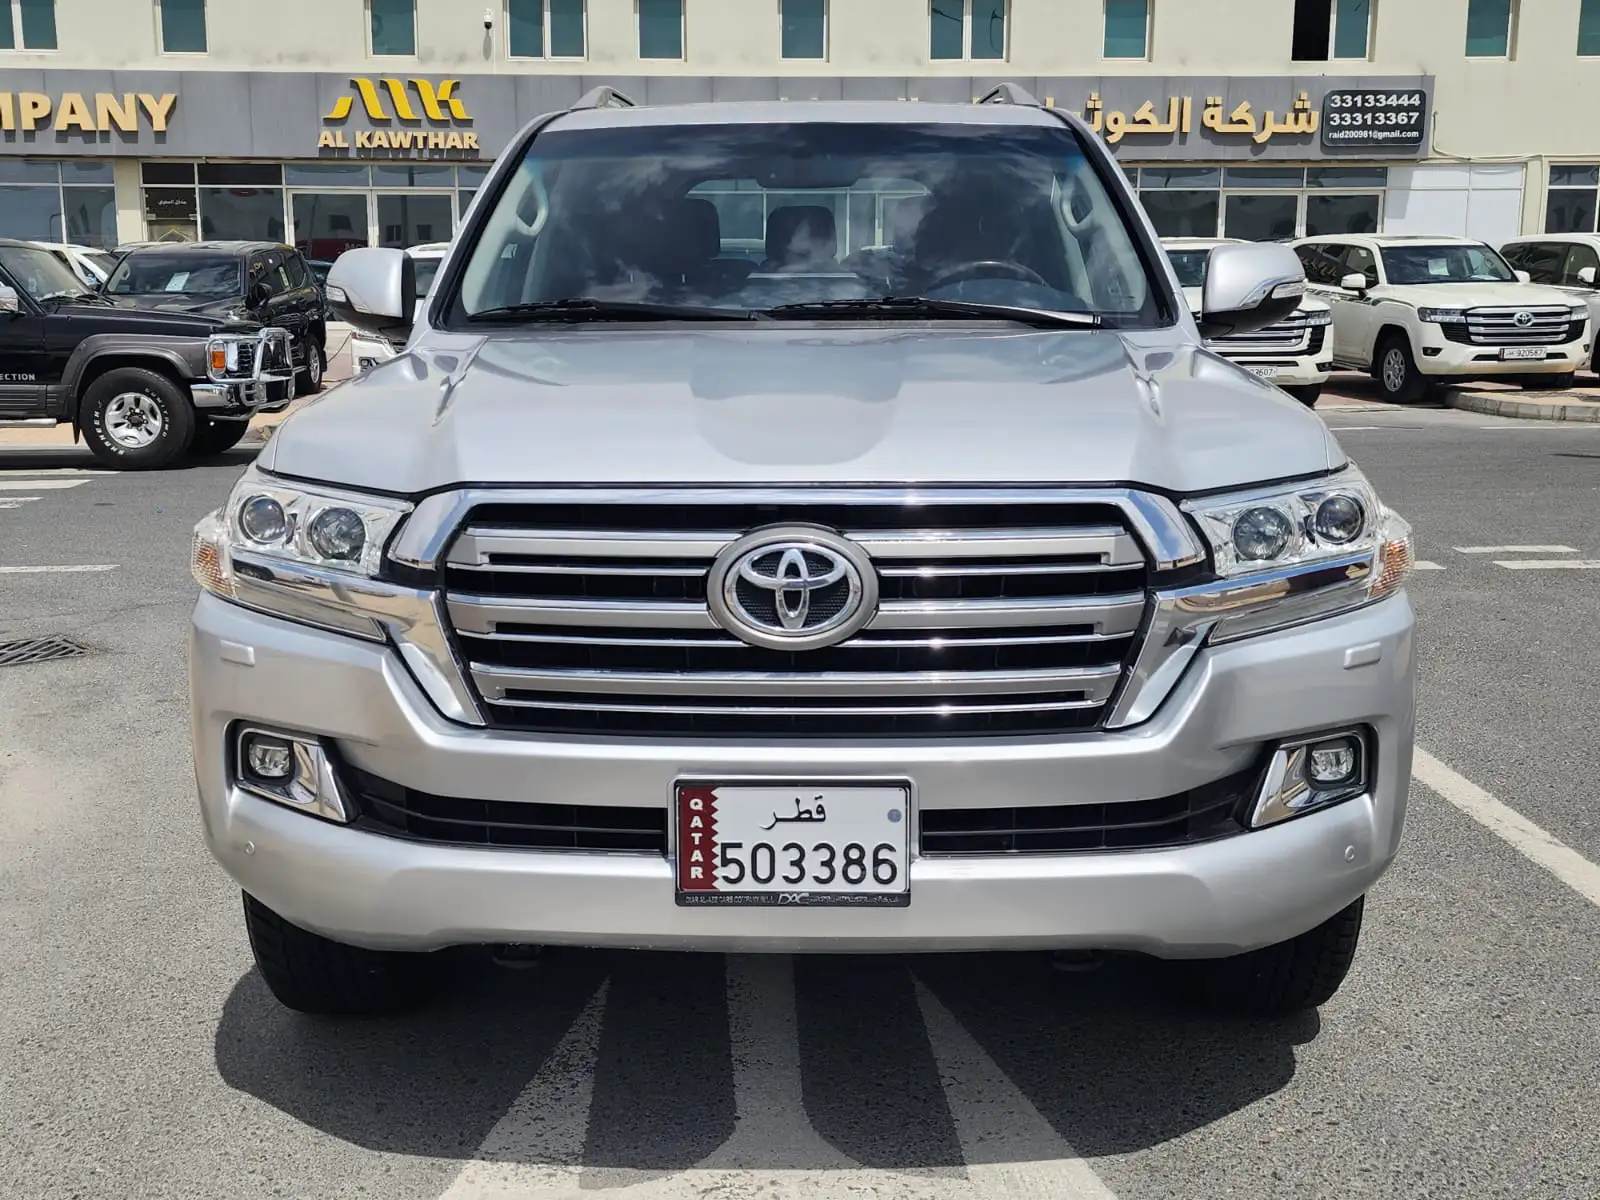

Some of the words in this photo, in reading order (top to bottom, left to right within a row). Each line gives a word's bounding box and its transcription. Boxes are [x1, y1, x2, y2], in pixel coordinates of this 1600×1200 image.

[1075, 92, 1192, 144] الكوث
[1203, 92, 1319, 144] شركة
[1330, 93, 1421, 107] 33133444
[1328, 129, 1419, 139] raid200981@gmail.com
[1329, 112, 1420, 126] 33313367
[317, 130, 349, 148] AL
[355, 131, 480, 149] KAWTHAR
[759, 794, 827, 831] قطر
[689, 798, 704, 880] QATAR
[720, 842, 898, 885] 503386
